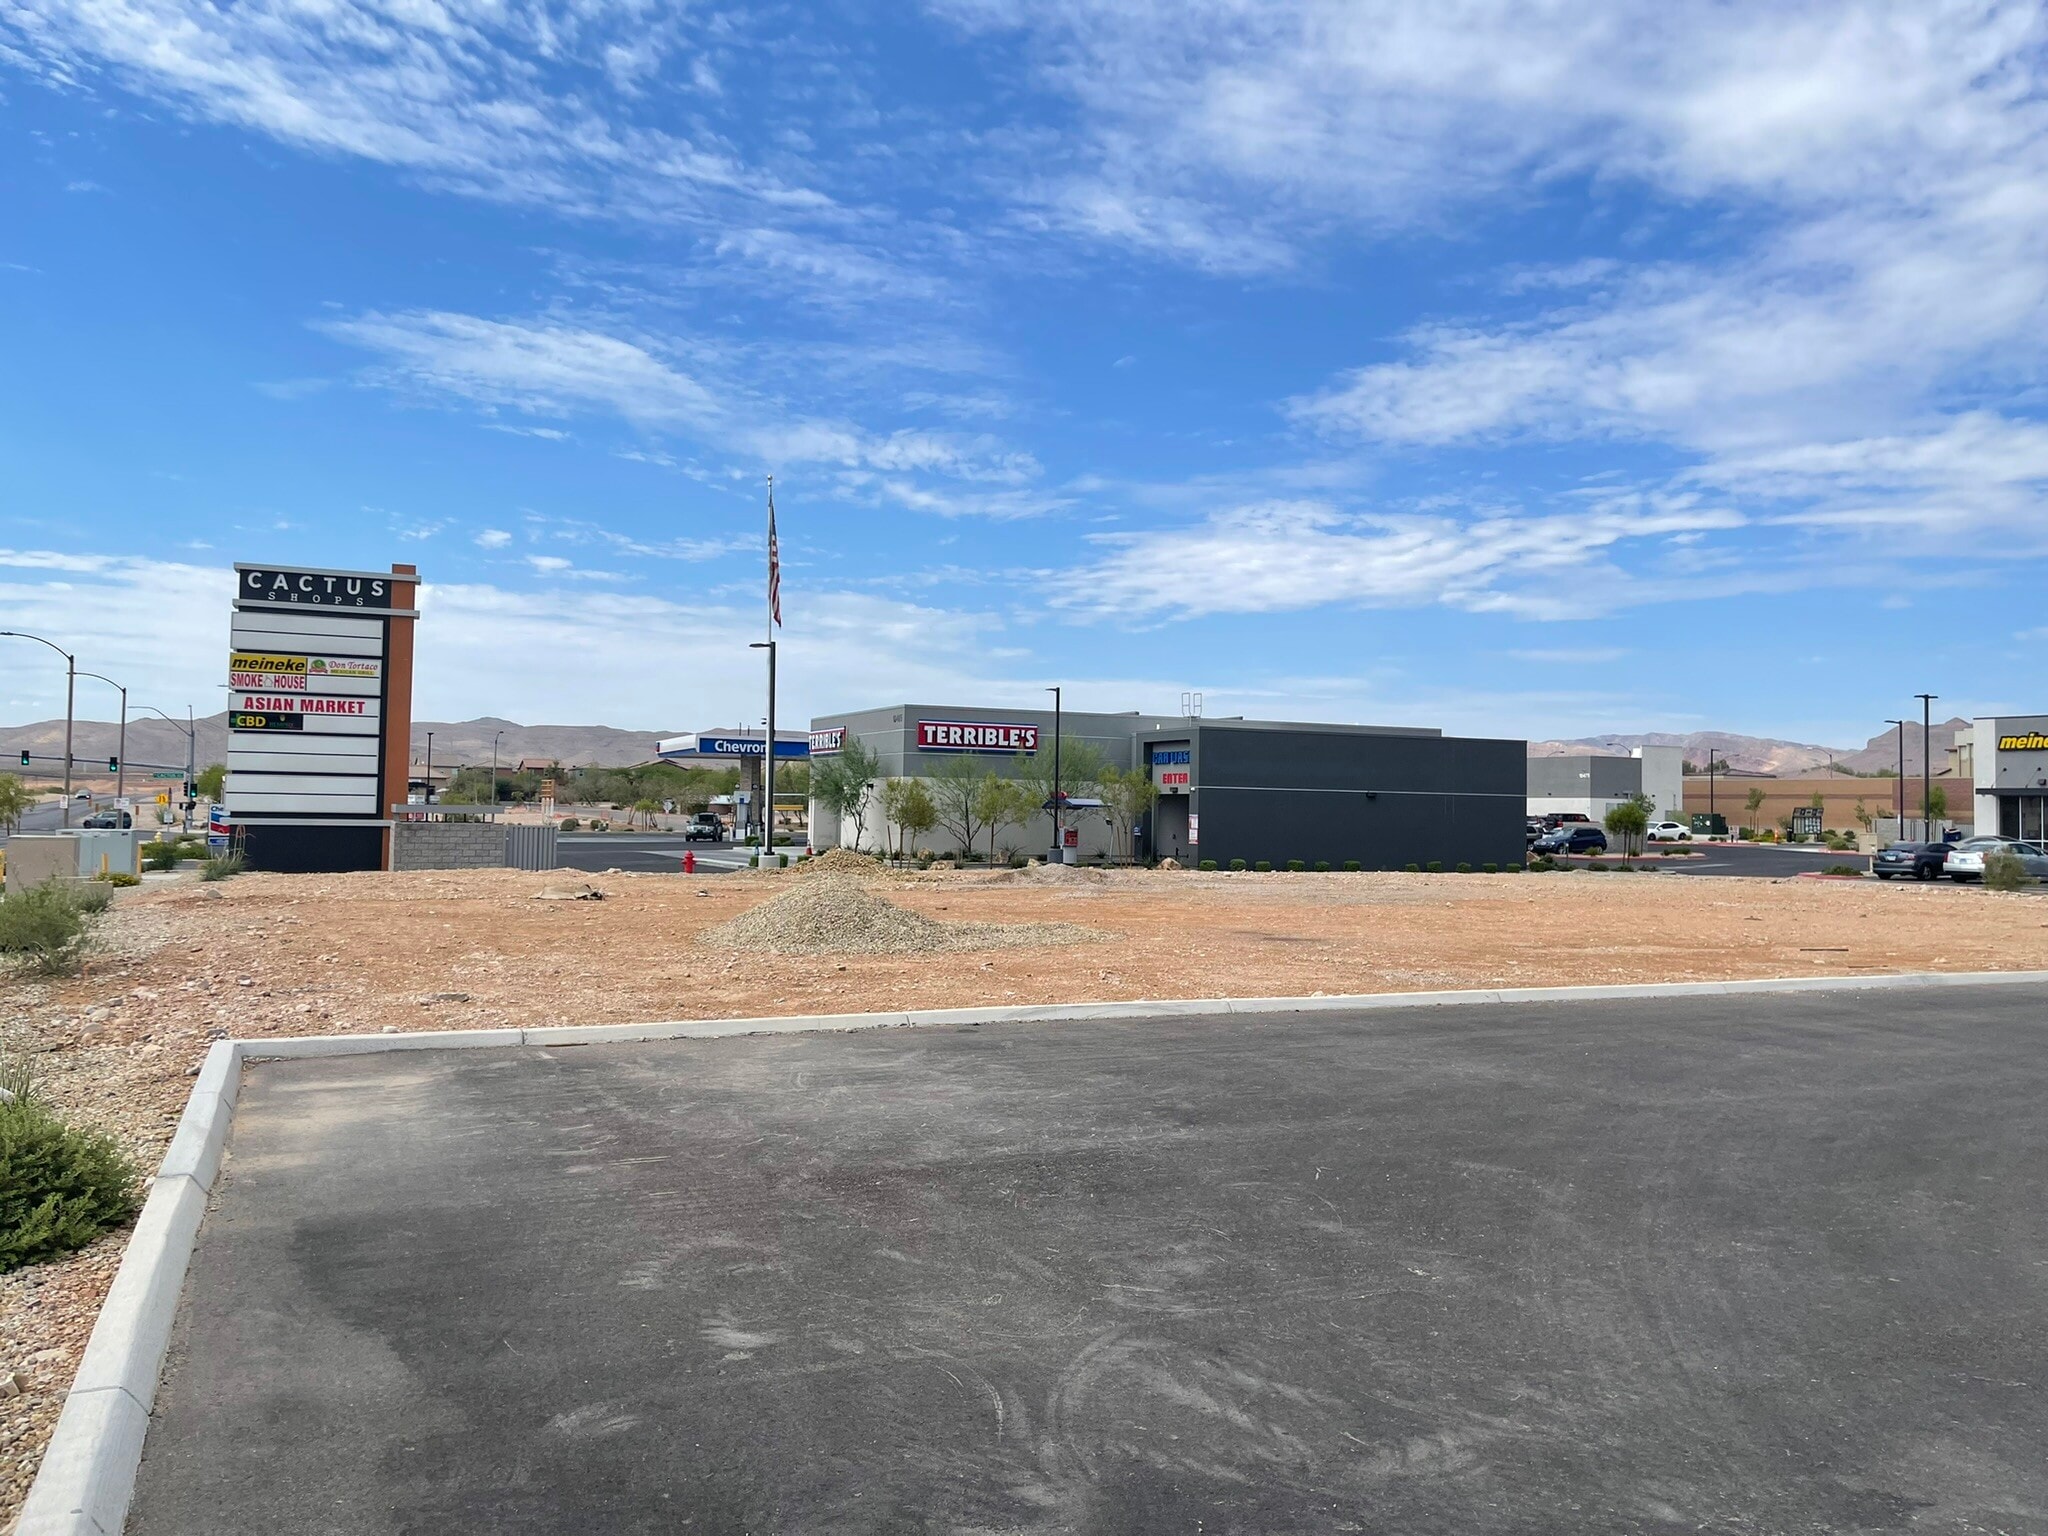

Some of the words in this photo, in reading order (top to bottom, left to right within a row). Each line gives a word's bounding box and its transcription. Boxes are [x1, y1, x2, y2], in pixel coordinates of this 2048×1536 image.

[247, 571, 384, 597] CACTUS
[268, 591, 364, 606] SHOPS
[231, 657, 305, 672] meineke
[328, 660, 346, 669] Don
[347, 661, 378, 671] Tortaco
[230, 673, 263, 687] SMOKE
[273, 674, 305, 689] HOUSE
[244, 697, 294, 711] ASIAN
[300, 699, 365, 714] MARKET
[236, 715, 266, 727] CBD
[924, 725, 1035, 747] TERRIBLE'S
[1170, 751, 1189, 764] WAS
[1162, 773, 1188, 784] ENTER
